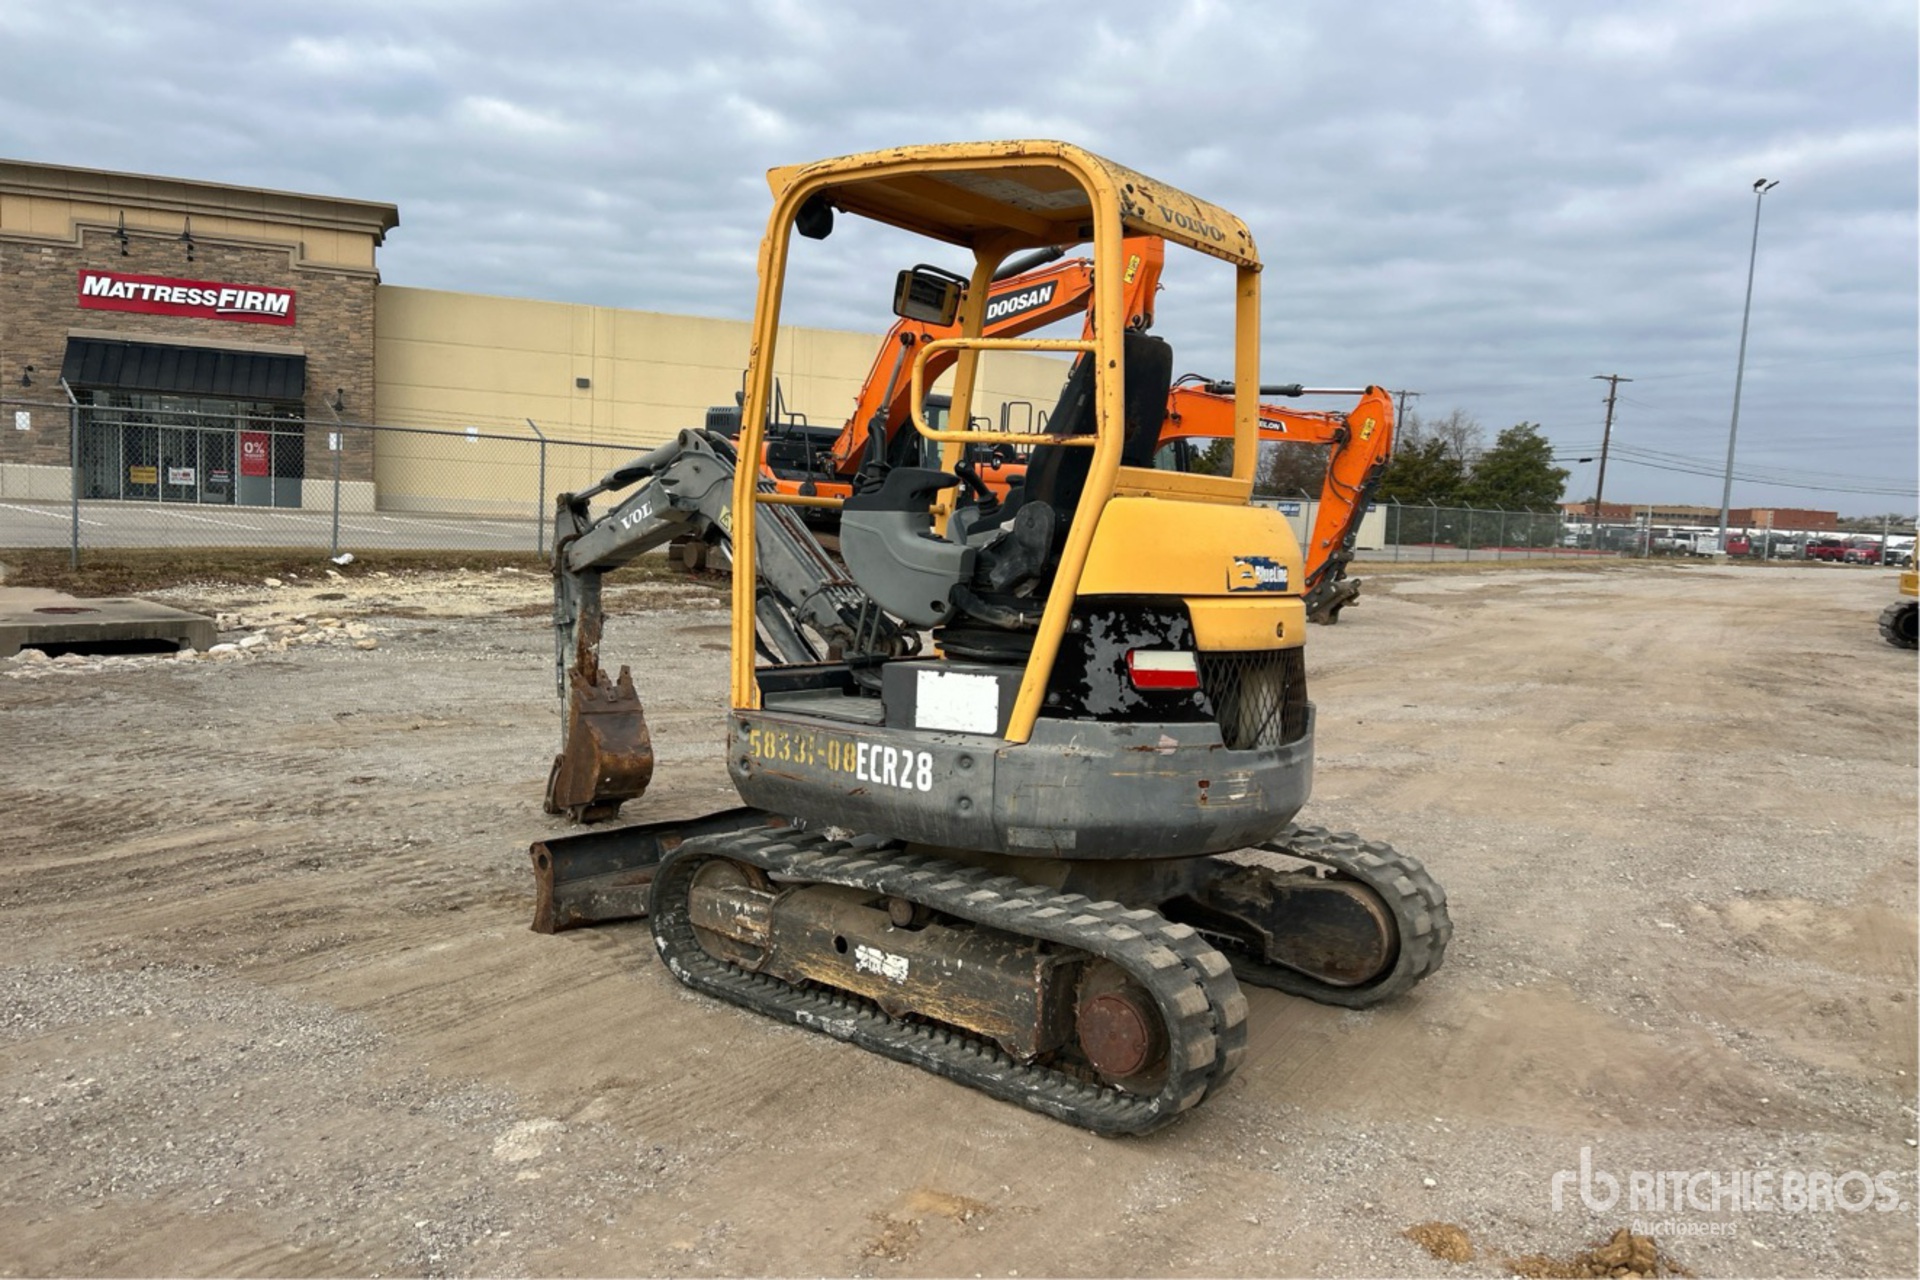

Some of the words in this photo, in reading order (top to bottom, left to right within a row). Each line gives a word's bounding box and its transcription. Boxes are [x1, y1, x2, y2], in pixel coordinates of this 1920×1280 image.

[1158, 205, 1223, 241] VOLVO
[986, 285, 1052, 320] DOOSAN
[244, 441, 265, 454] 0%
[620, 501, 653, 530] VOL
[856, 742, 933, 792] ECR28
